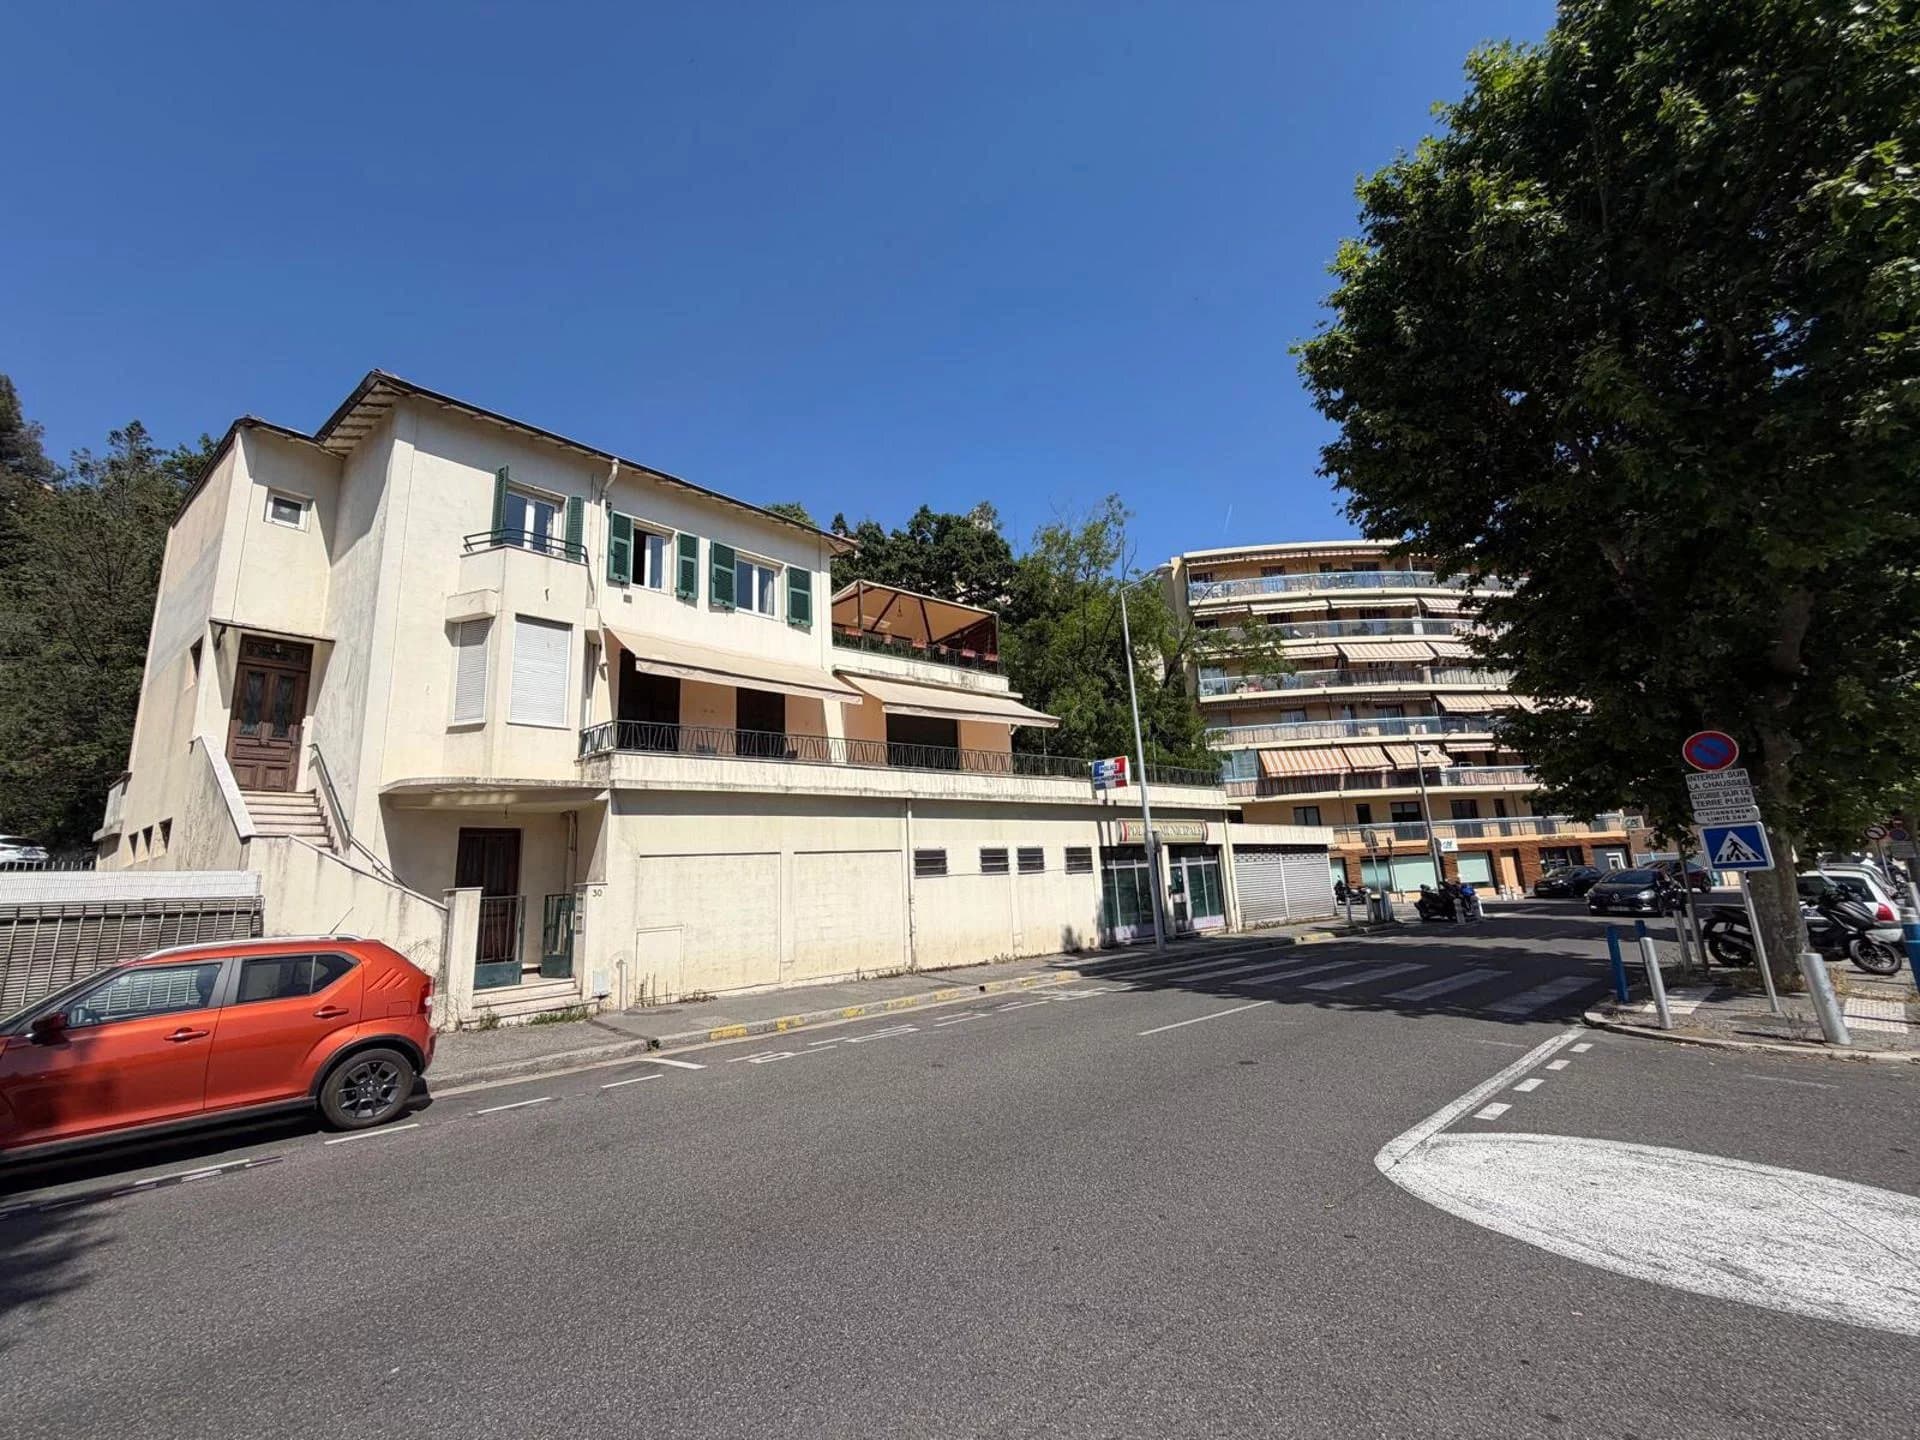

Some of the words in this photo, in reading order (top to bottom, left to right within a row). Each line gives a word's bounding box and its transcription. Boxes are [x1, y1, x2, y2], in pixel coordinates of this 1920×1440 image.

[1687, 773, 1723, 782] INTERDIT
[1689, 783, 1700, 791] LA
[1696, 799, 1723, 807] TERRE
[1698, 807, 1754, 817] STATIONNEMENT
[592, 888, 603, 897] 30
